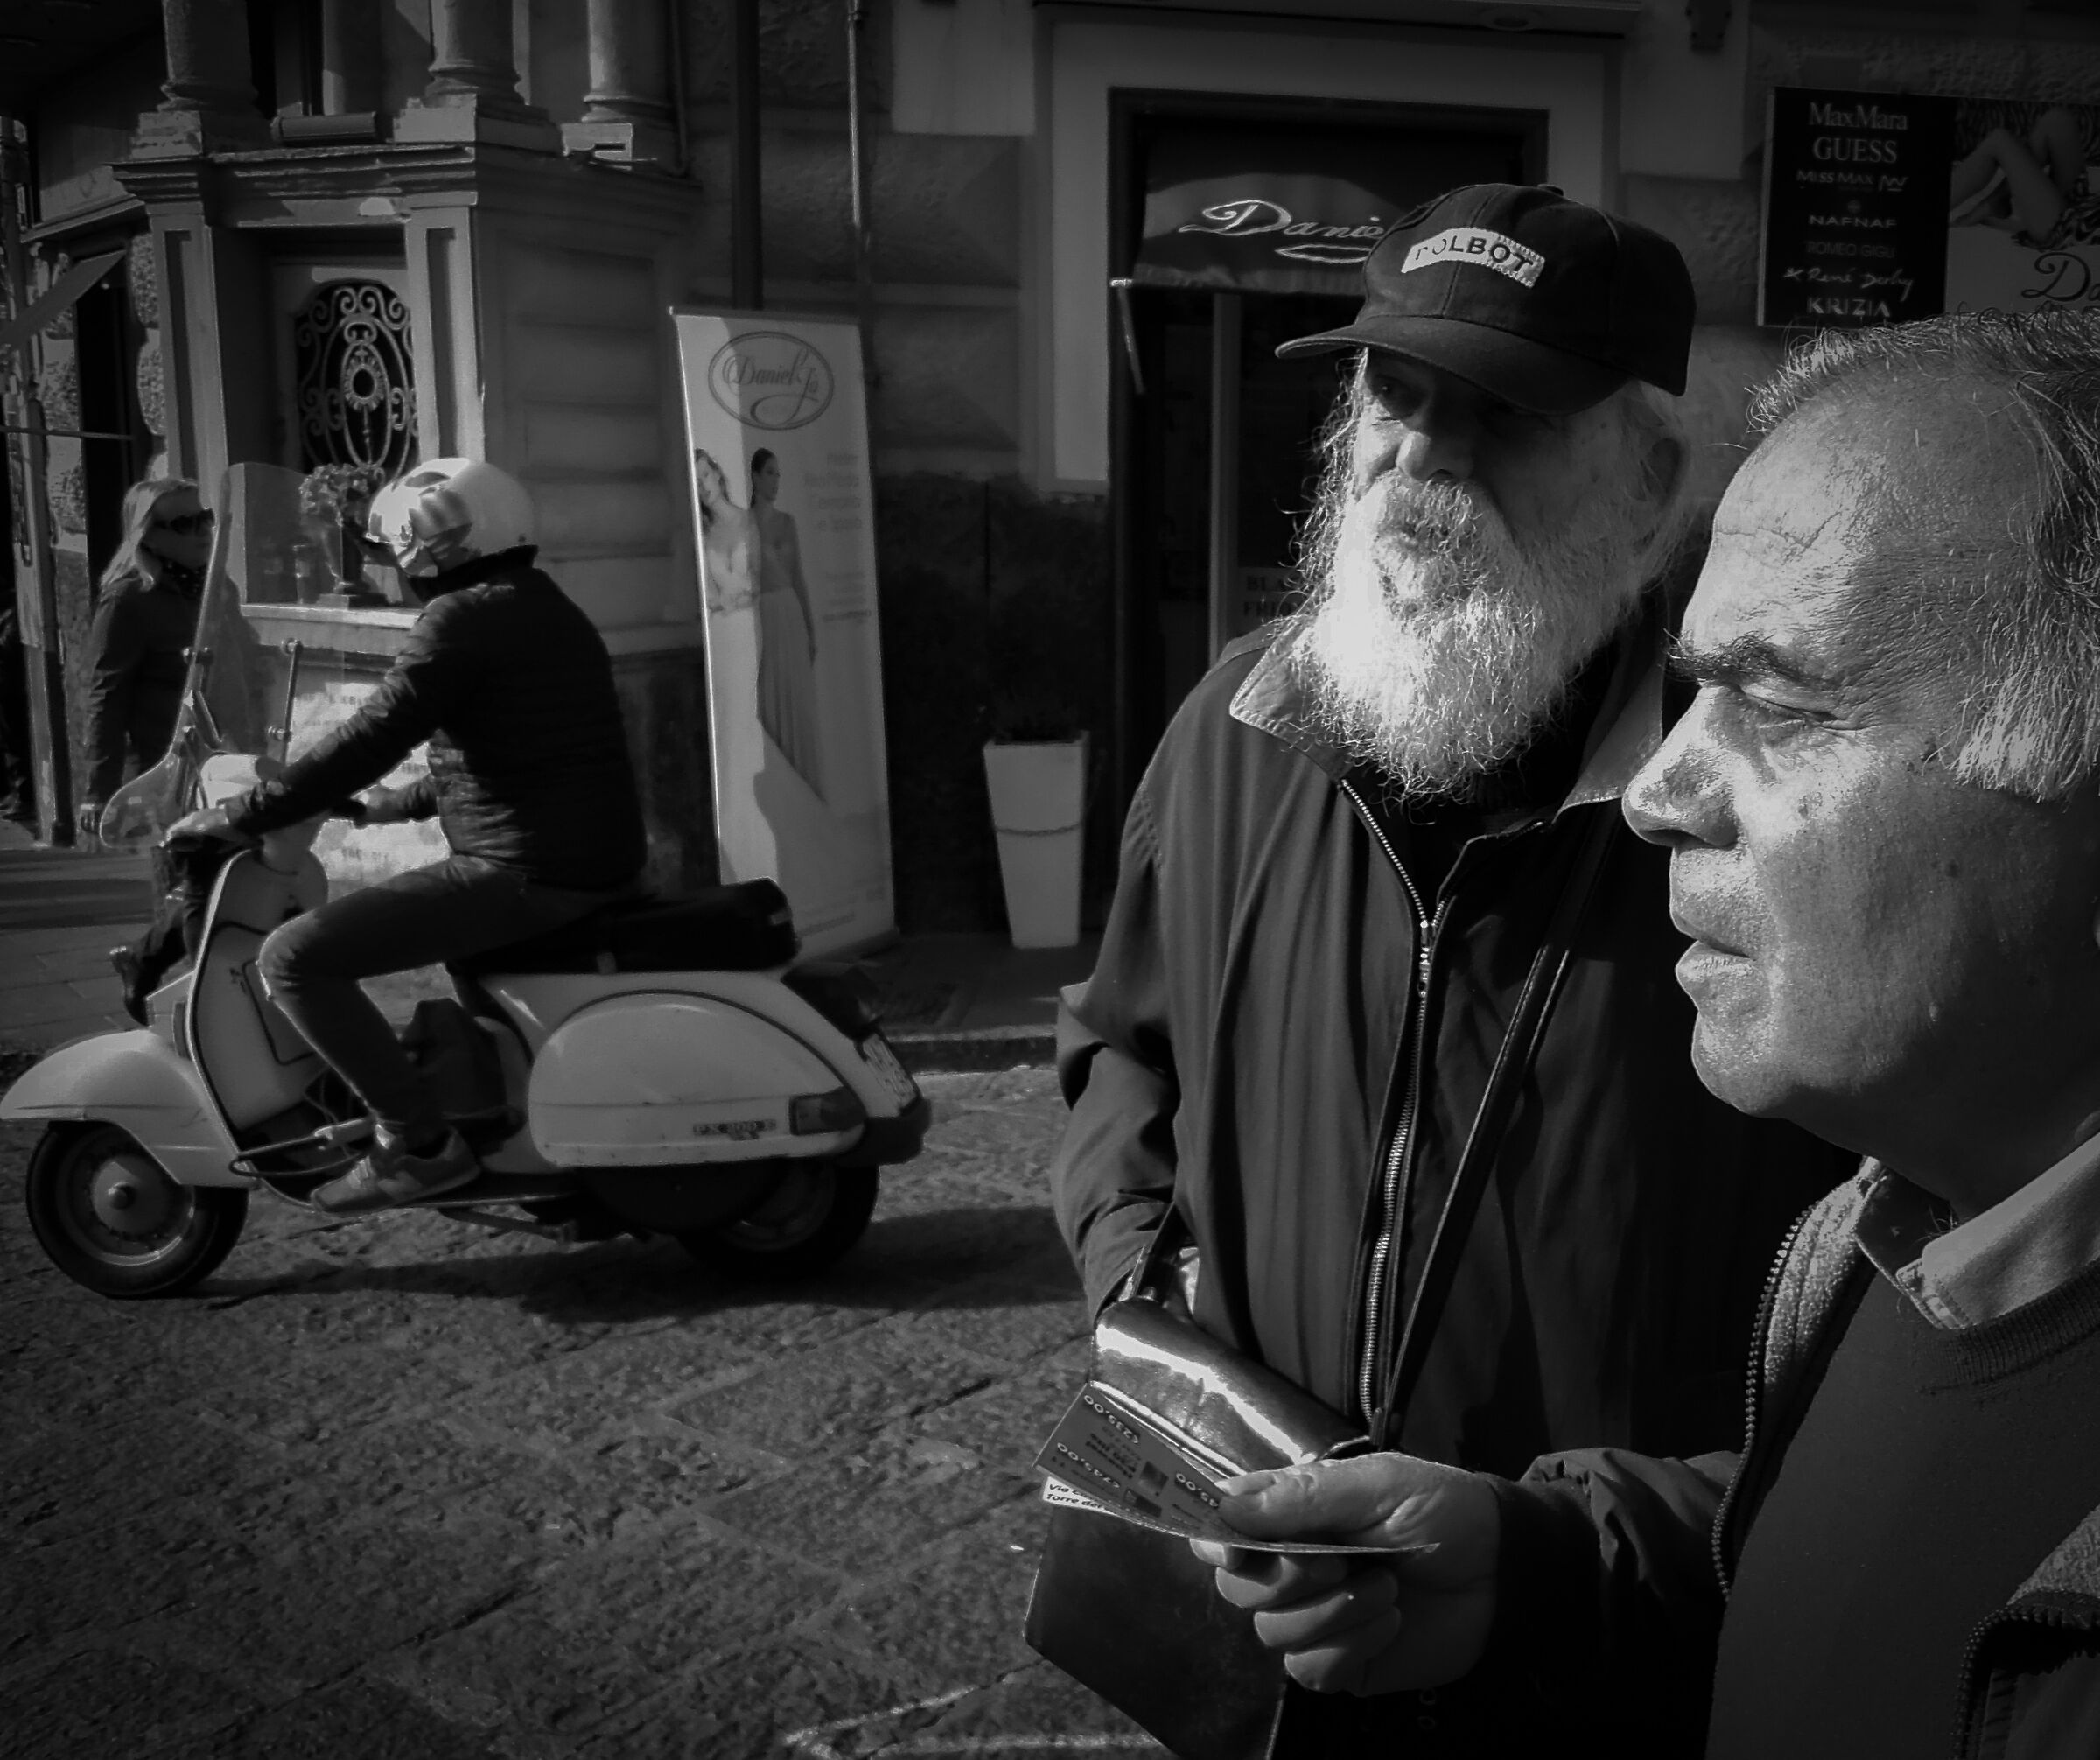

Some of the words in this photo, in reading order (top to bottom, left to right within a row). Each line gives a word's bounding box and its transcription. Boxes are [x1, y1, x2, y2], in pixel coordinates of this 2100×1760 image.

[1808, 102, 1909, 130] MaxMara
[1812, 137, 1898, 164] GUESS
[1808, 214, 1898, 228] NAFNAF
[1805, 241, 1857, 256] ROMEO
[1806, 298, 1890, 318] KRIZIA
[1049, 1483, 1069, 1493] Via
[1046, 1493, 1080, 1504] Torre
